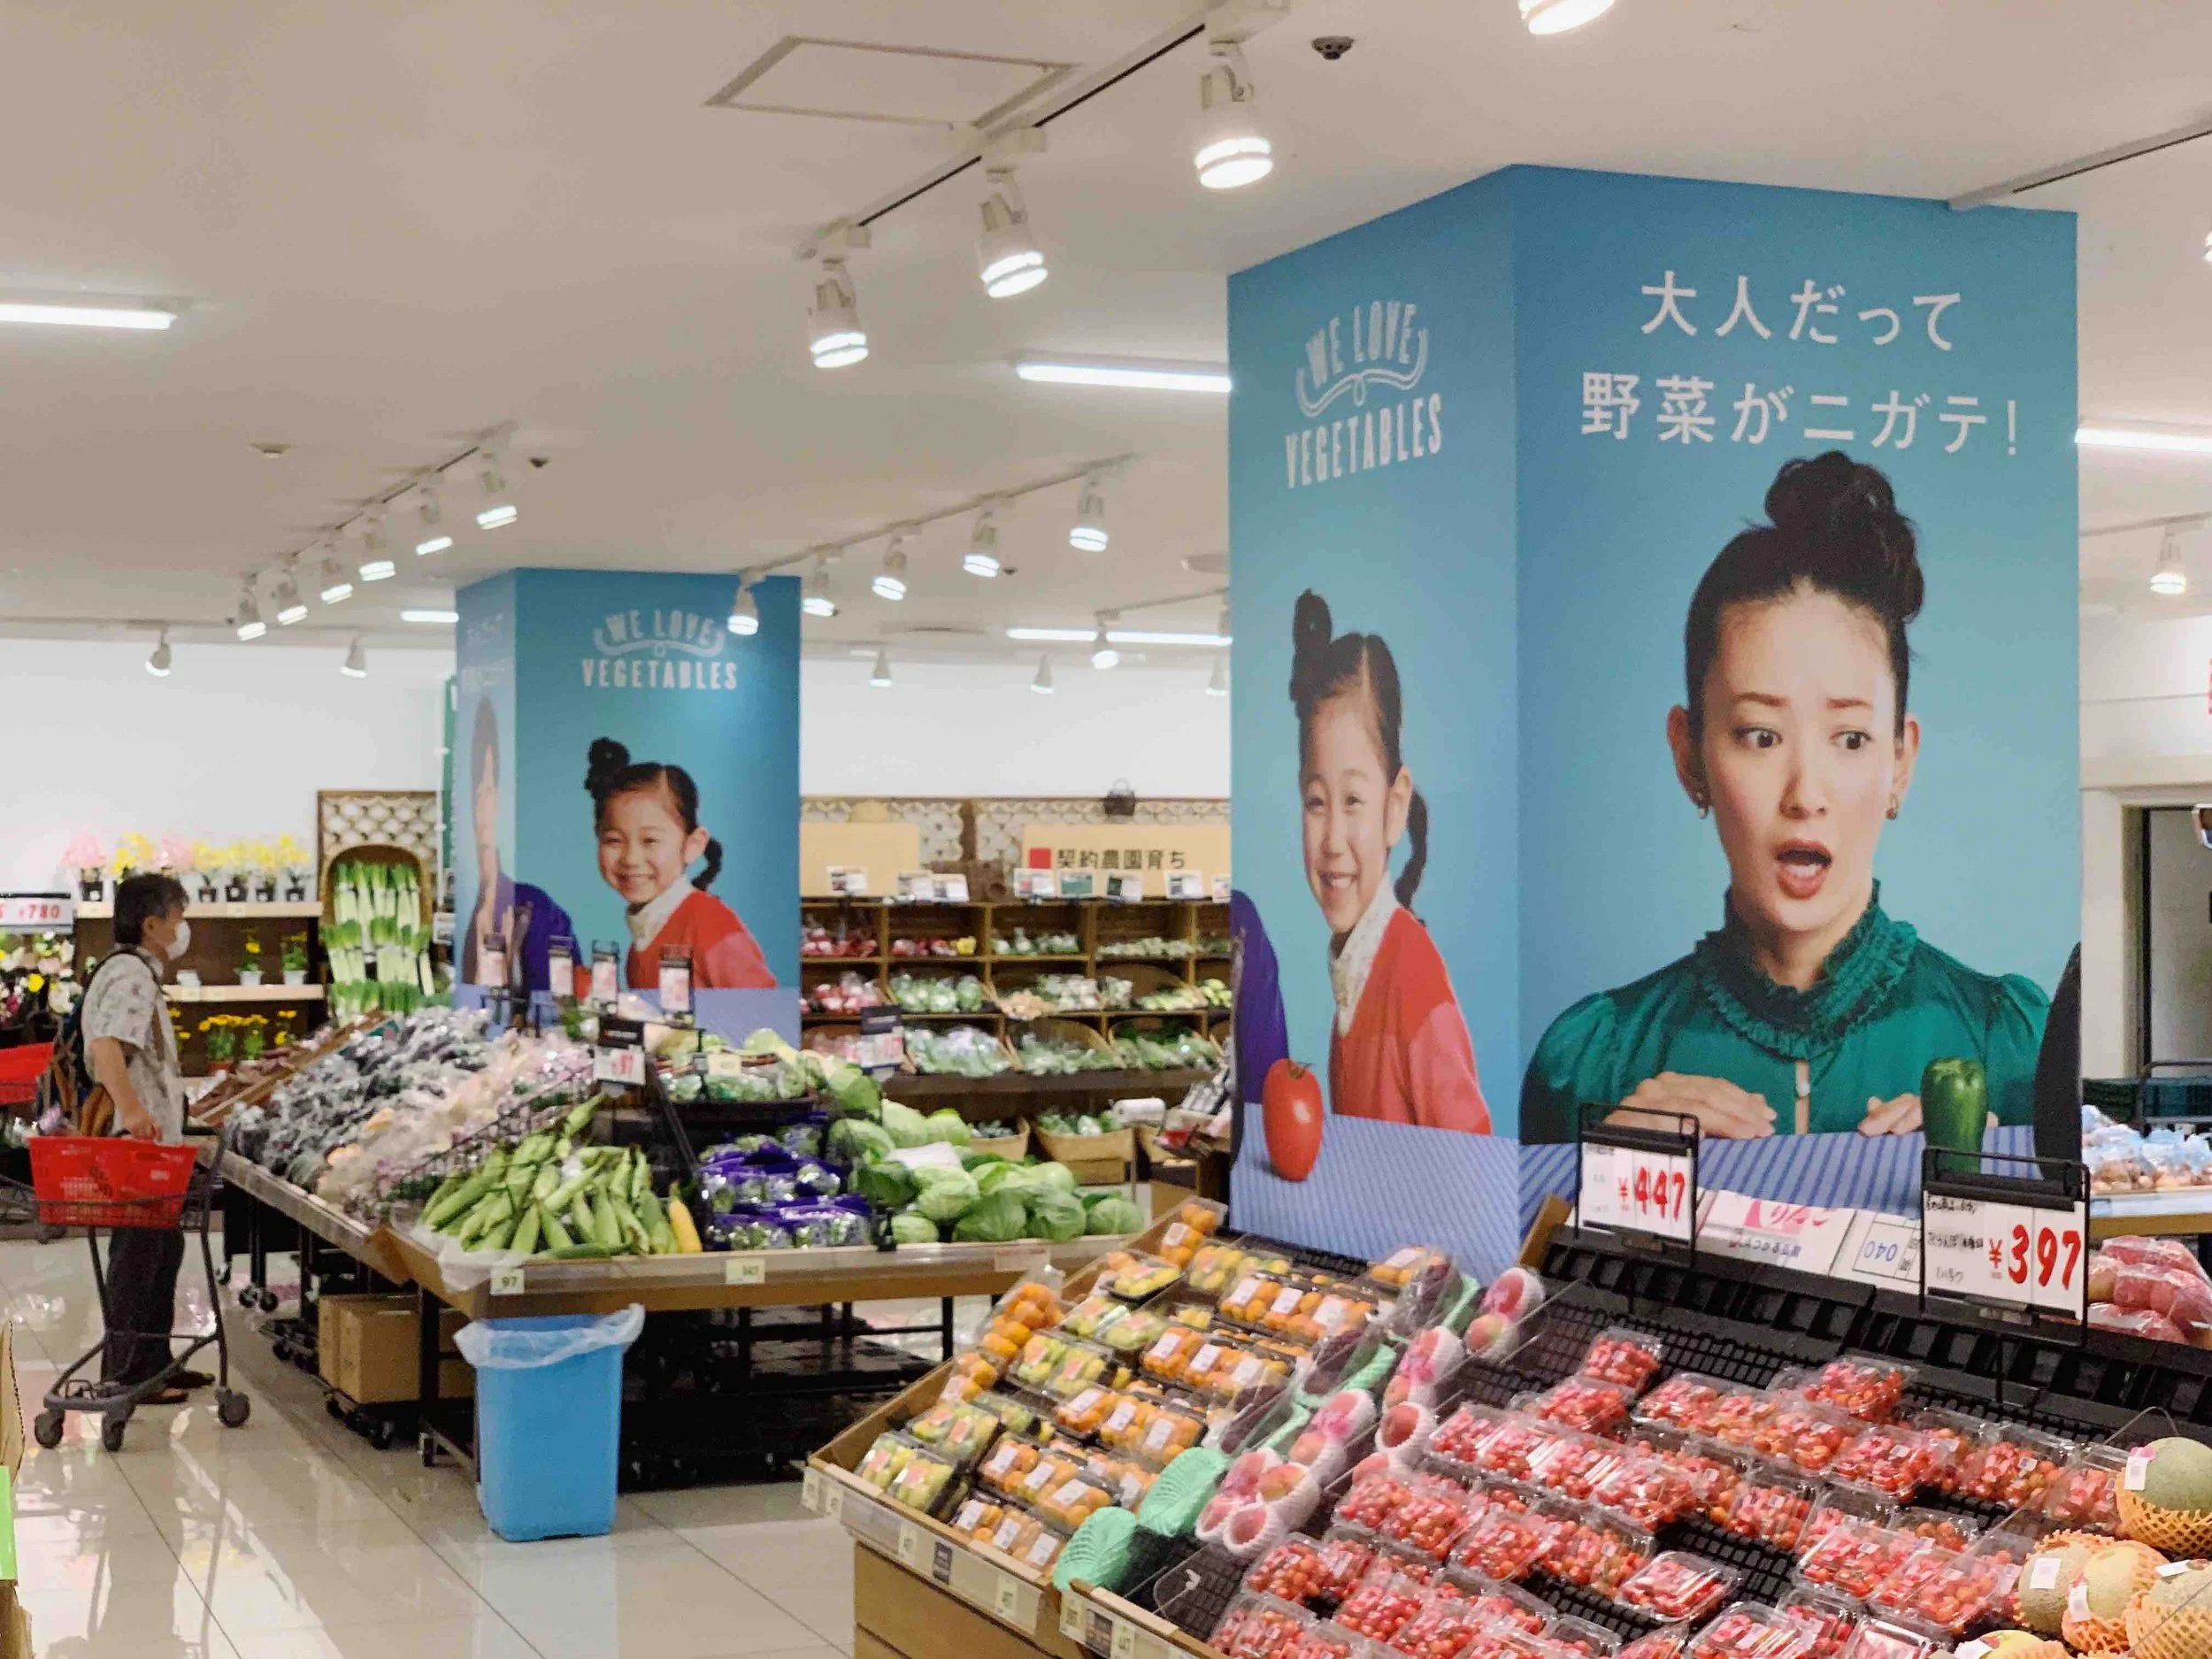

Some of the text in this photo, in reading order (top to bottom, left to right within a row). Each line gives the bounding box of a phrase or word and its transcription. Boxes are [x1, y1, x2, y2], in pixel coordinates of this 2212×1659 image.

[1640, 269, 1962, 351] 大人だって
[1304, 300, 1418, 390] WE LOVE
[1285, 392, 1443, 489] VEGETABLES
[605, 608, 716, 646] WE LOVE
[581, 657, 738, 691] VEGETABLES
[1056, 849, 1187, 871] 契約農園育ち
[1987, 1223, 2082, 1291] ¥397
